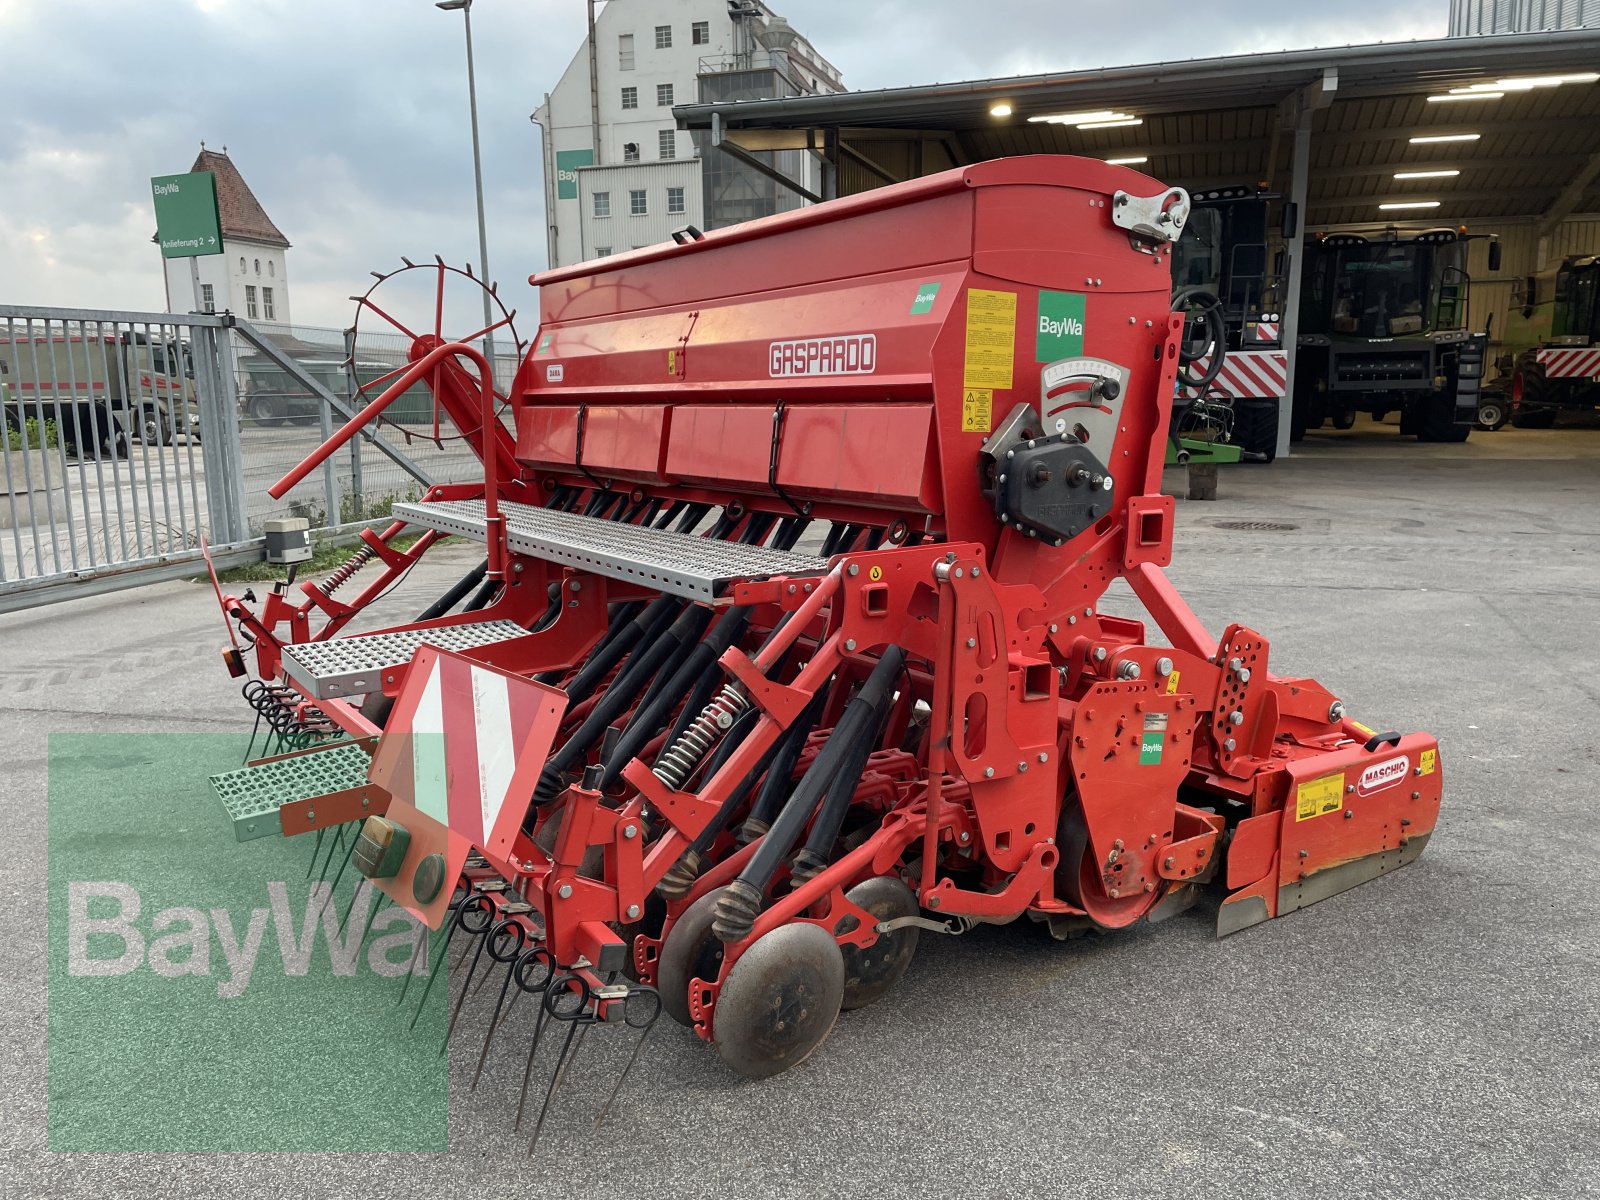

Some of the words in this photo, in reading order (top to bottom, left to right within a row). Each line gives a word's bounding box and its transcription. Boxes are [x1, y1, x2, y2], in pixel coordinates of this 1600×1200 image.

[154, 183, 179, 196] BayWa
[162, 238, 198, 249] Anlieferung
[199, 237, 204, 246] 2
[915, 293, 936, 304] BayWa
[1039, 315, 1083, 338] BayWa
[770, 336, 875, 375] GASPARDO
[1142, 743, 1163, 754] BayWa
[1365, 761, 1406, 781] MASCHIO
